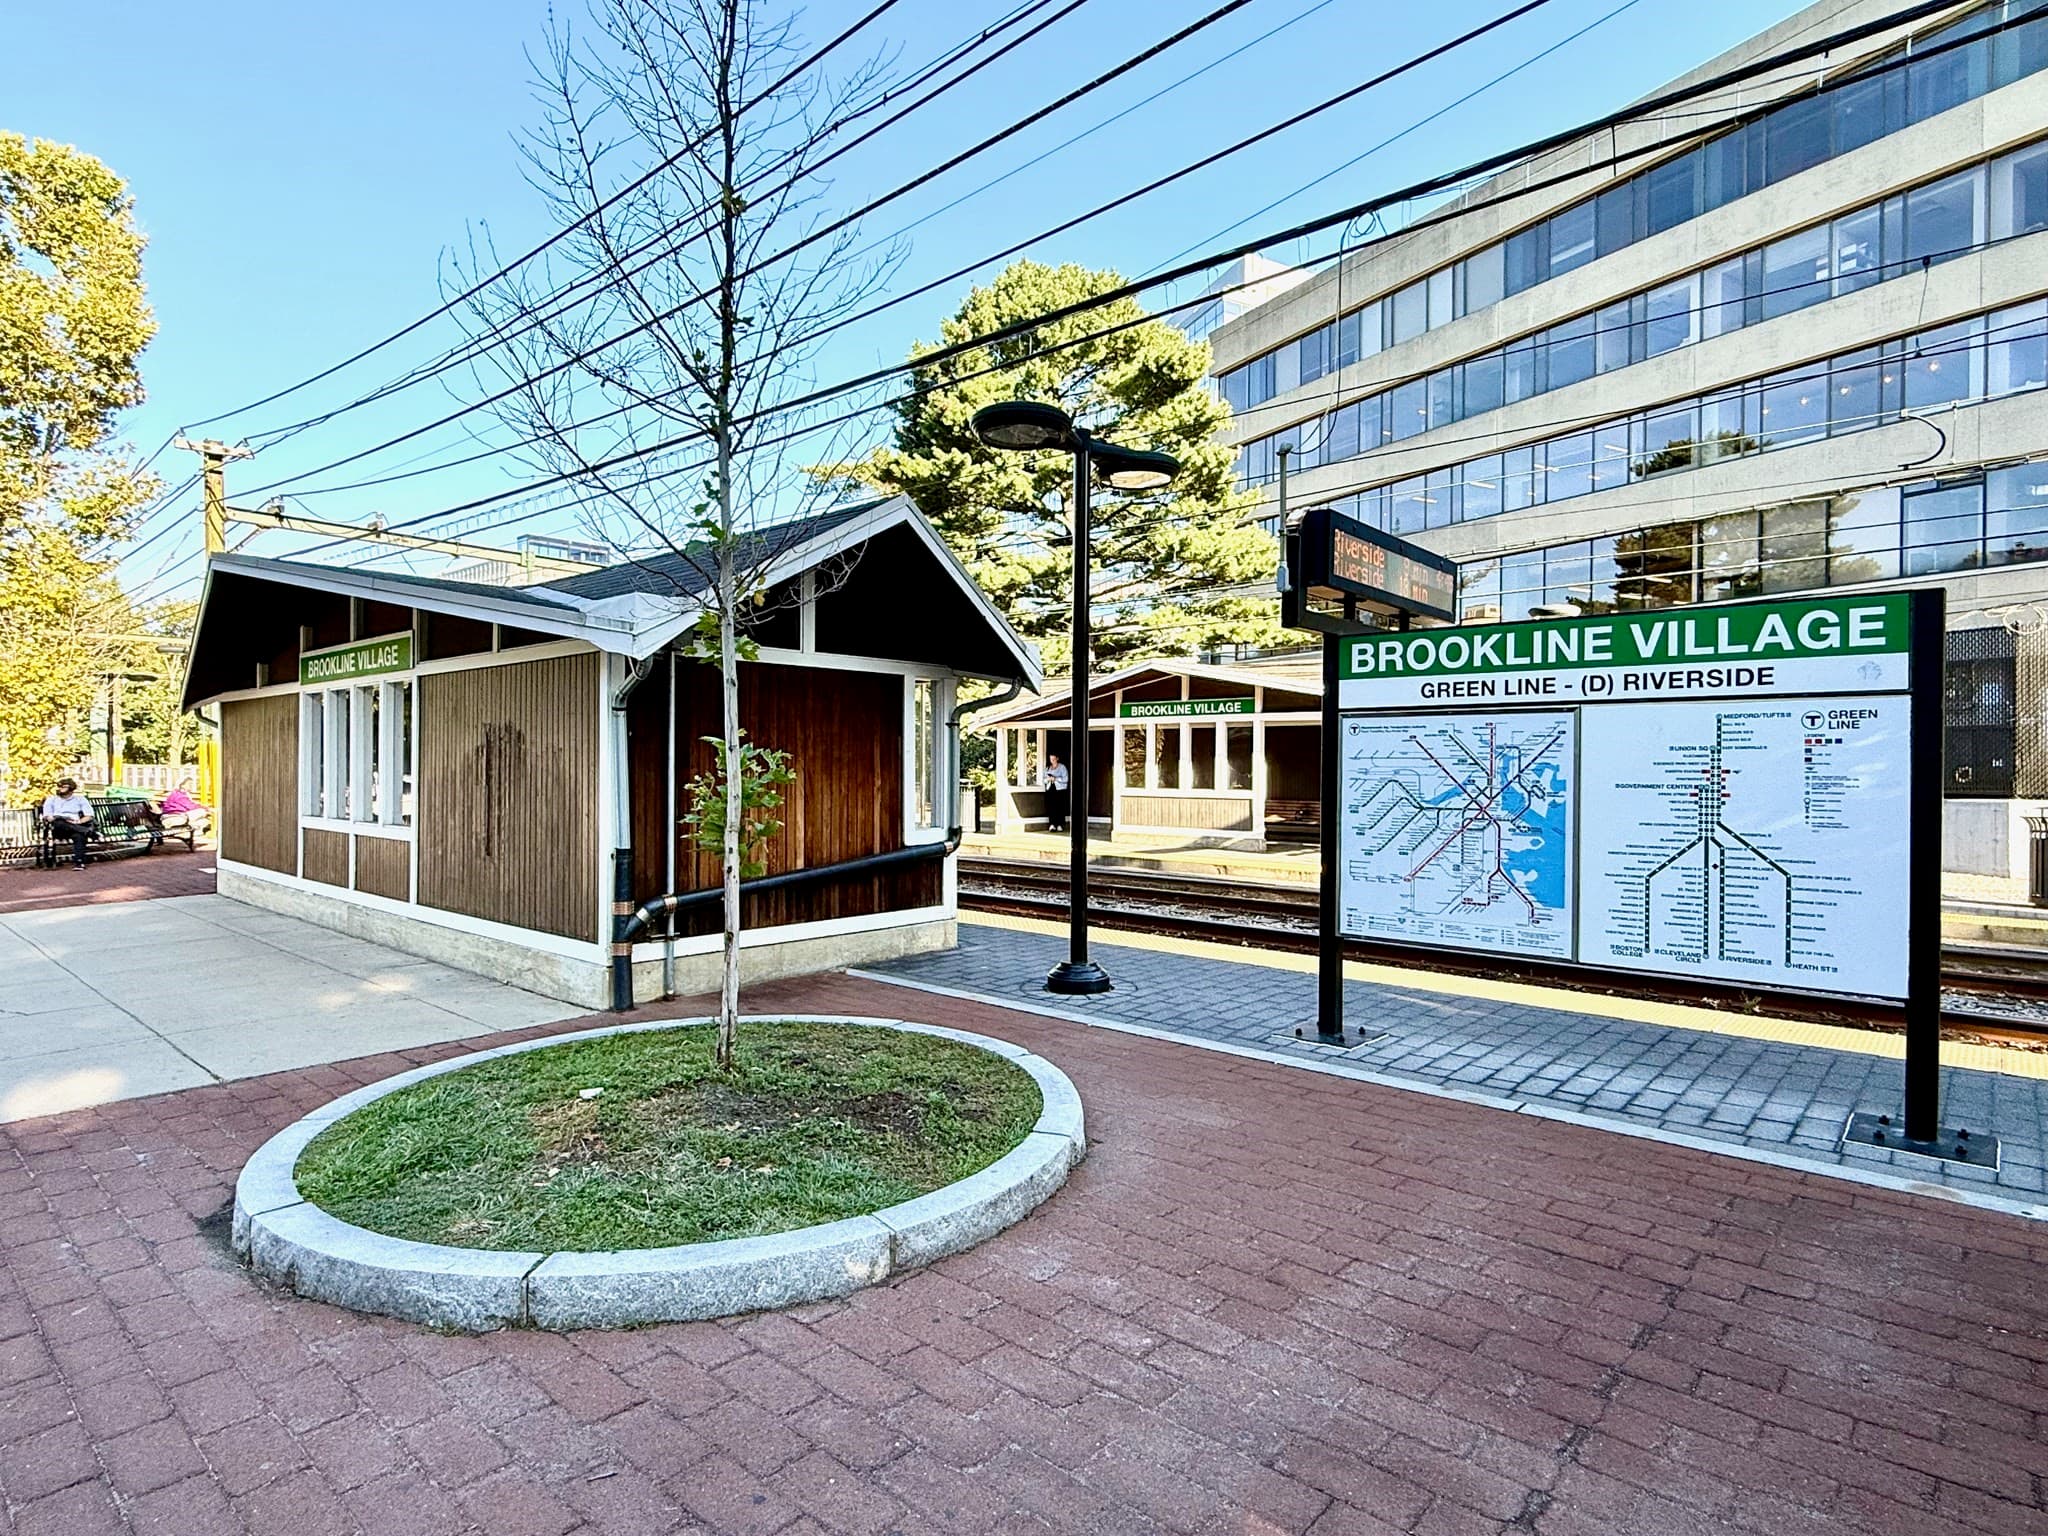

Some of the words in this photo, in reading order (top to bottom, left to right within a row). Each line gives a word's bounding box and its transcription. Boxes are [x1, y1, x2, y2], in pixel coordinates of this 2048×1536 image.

[1334, 528, 1385, 569] Riverside
[1333, 551, 1384, 589] Riverside
[1351, 625, 1613, 674] BROOKLINE
[1629, 605, 1887, 658] VILLAGE
[307, 652, 356, 679] BROOKLINE
[357, 644, 399, 671] VILLAGE
[1420, 680, 1496, 699] GREEN
[1504, 677, 1556, 696] LINE
[1581, 675, 1614, 696] (D)
[1623, 667, 1775, 692] RIVERSIDE
[1131, 704, 1192, 716] BROOKLINE
[1194, 702, 1241, 714] VILLAGE
[1828, 709, 1878, 719] GREEN
[1828, 720, 1861, 729] LINE
[1615, 944, 1643, 952] BOSTON
[1660, 948, 1701, 958] CLEVELAND
[1612, 949, 1643, 958] COLLEGE
[1675, 956, 1701, 964] CIRCLE
[1726, 955, 1765, 965] RIVERSIDE
[1792, 963, 1819, 972] HEATH
[1820, 965, 1831, 973] ST
